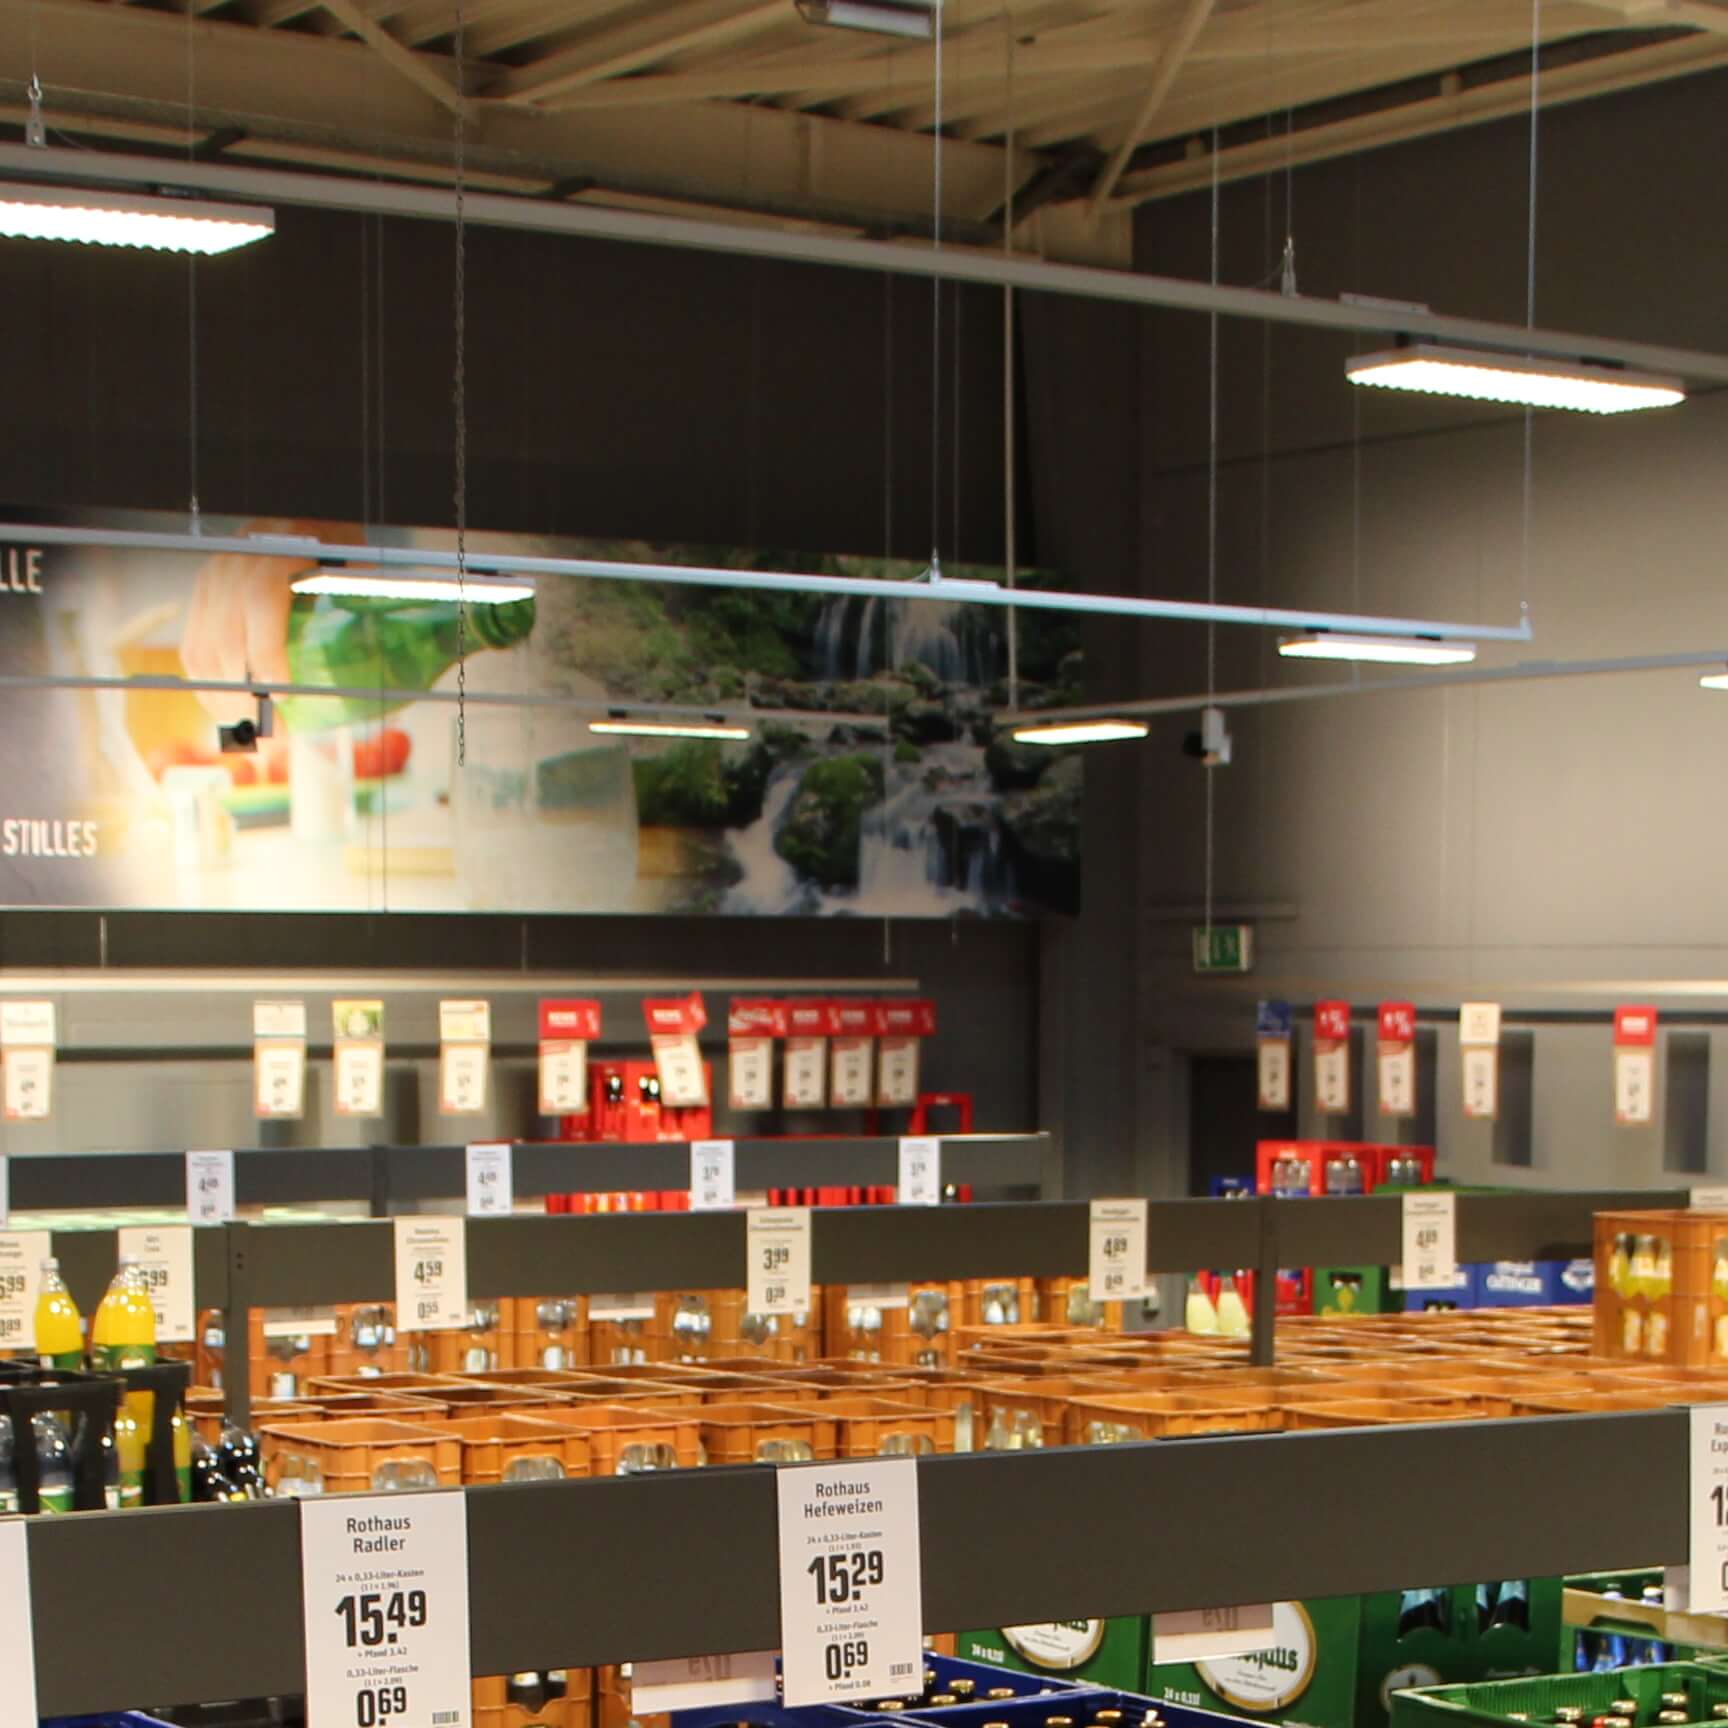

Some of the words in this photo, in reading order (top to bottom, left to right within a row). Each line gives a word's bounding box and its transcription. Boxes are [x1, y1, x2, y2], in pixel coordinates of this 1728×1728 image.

[1, 818, 98, 858] STILLES
[816, 1481, 871, 1498] Rothaus
[804, 1498, 883, 1519] Hefeweizen
[346, 1516, 411, 1534] Rothaus
[353, 1536, 406, 1553] Radler
